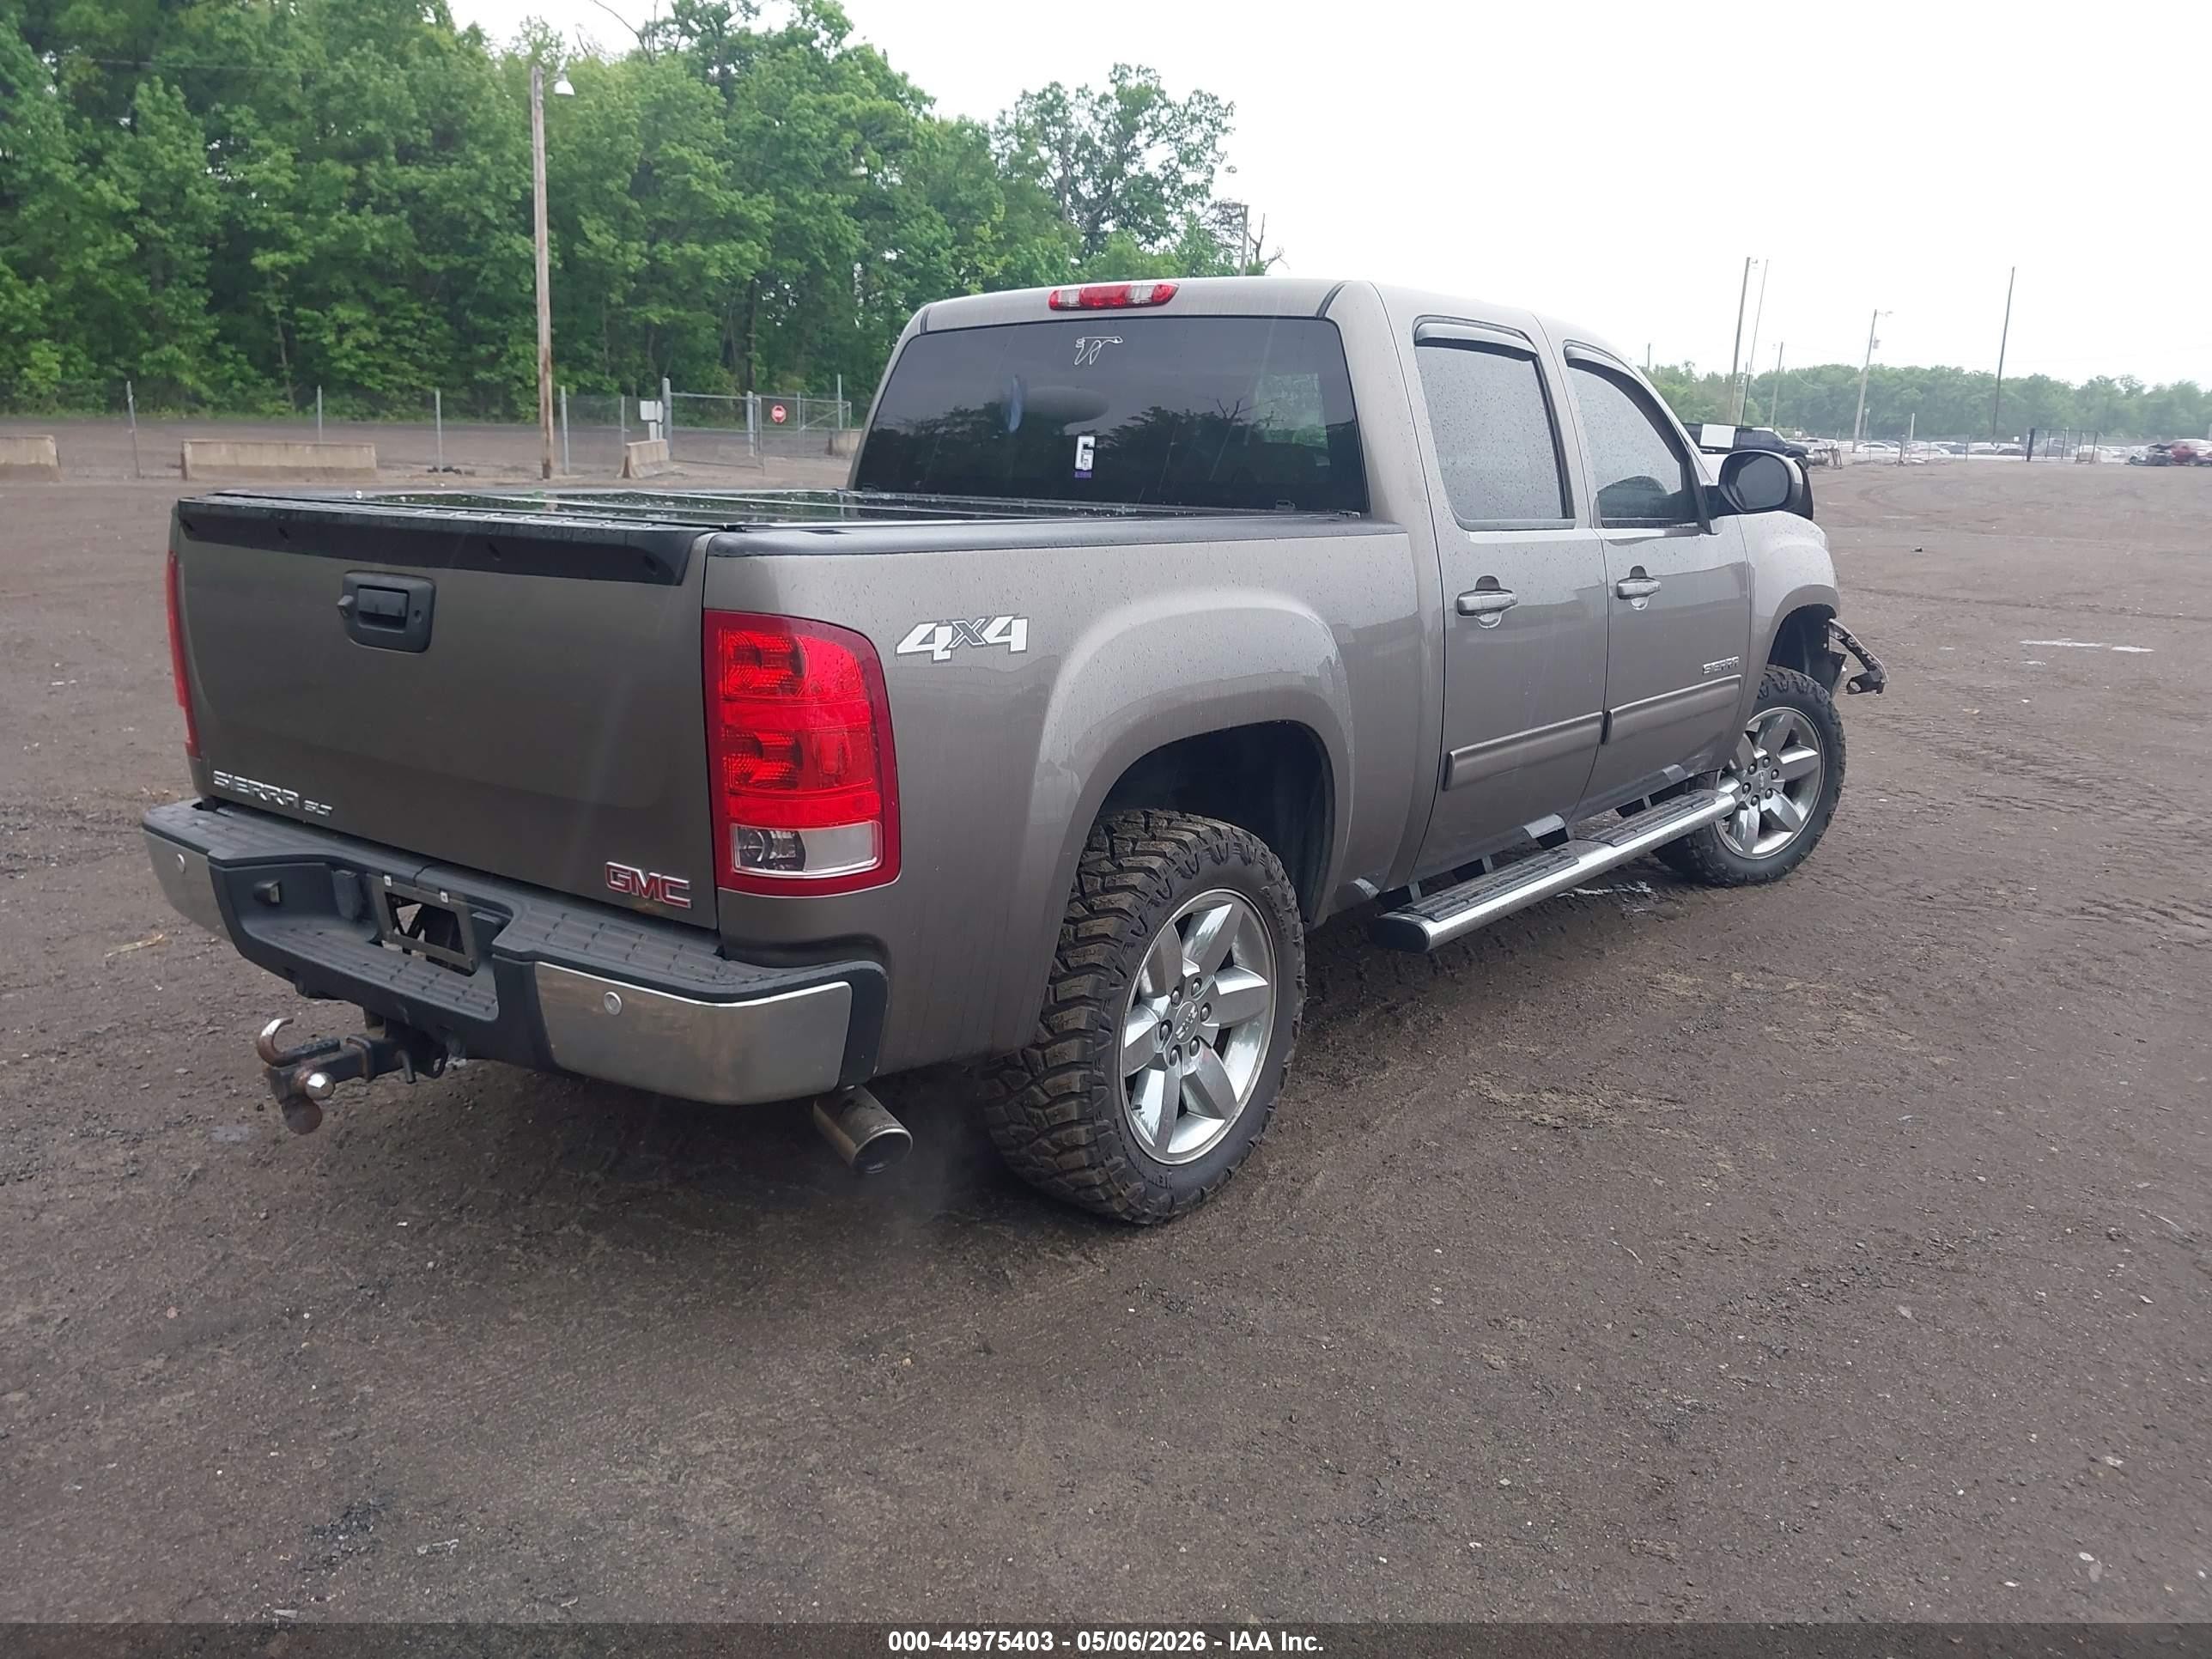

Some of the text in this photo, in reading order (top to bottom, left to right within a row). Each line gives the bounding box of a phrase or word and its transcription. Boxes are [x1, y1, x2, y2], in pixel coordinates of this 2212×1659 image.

[1703, 656, 1740, 674] SIERRA
[214, 770, 301, 810] SIERRA
[605, 860, 692, 908] GMC
